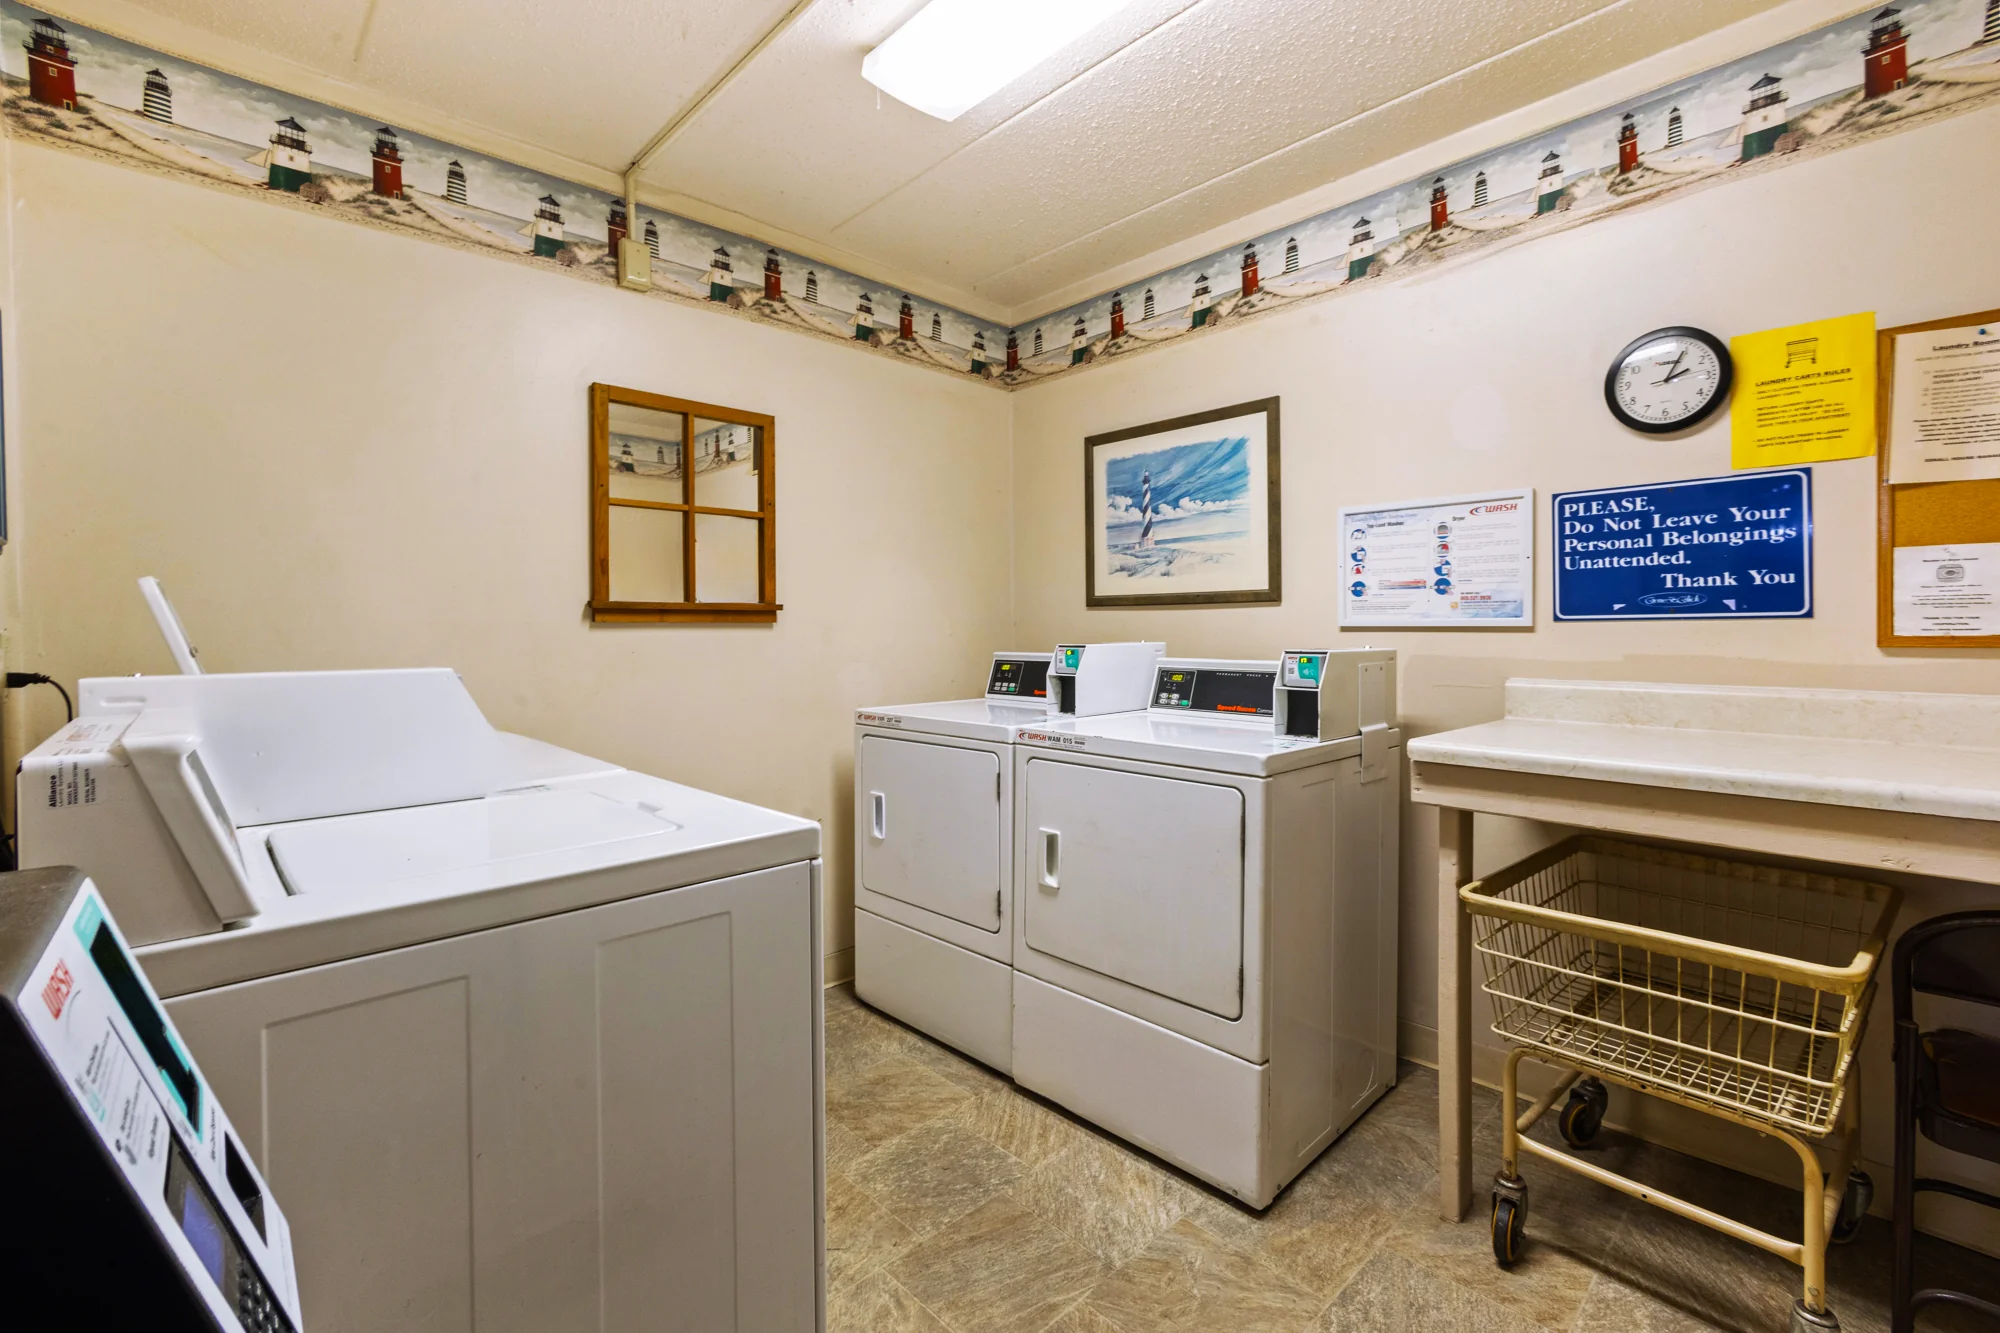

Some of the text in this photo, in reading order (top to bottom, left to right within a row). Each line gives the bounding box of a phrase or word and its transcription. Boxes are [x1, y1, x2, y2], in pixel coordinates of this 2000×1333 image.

[1698, 355, 1706, 365] 2
[1631, 366, 1641, 375] 10
[1755, 377, 1792, 387] LAUNDRY
[1795, 372, 1822, 381] CARTS
[1824, 368, 1851, 376] RULES
[1624, 381, 1632, 391] 9
[1696, 388, 1704, 397] 4
[1629, 396, 1637, 406] 8
[1682, 401, 1689, 411] 5
[1643, 404, 1652, 414] 7
[1661, 408, 1670, 417] 6
[1485, 503, 1518, 513] WASH
[1563, 496, 1656, 518] PLEASE,
[1563, 506, 1791, 535] Do Not Leave Your
[1564, 525, 1797, 552] Personal Belongings
[1564, 551, 1692, 570] Unattended.
[1660, 569, 1796, 589] Thank You
[1027, 732, 1047, 741] WASH
[48, 774, 57, 808] Alliance
[41, 957, 74, 1020] WASH
